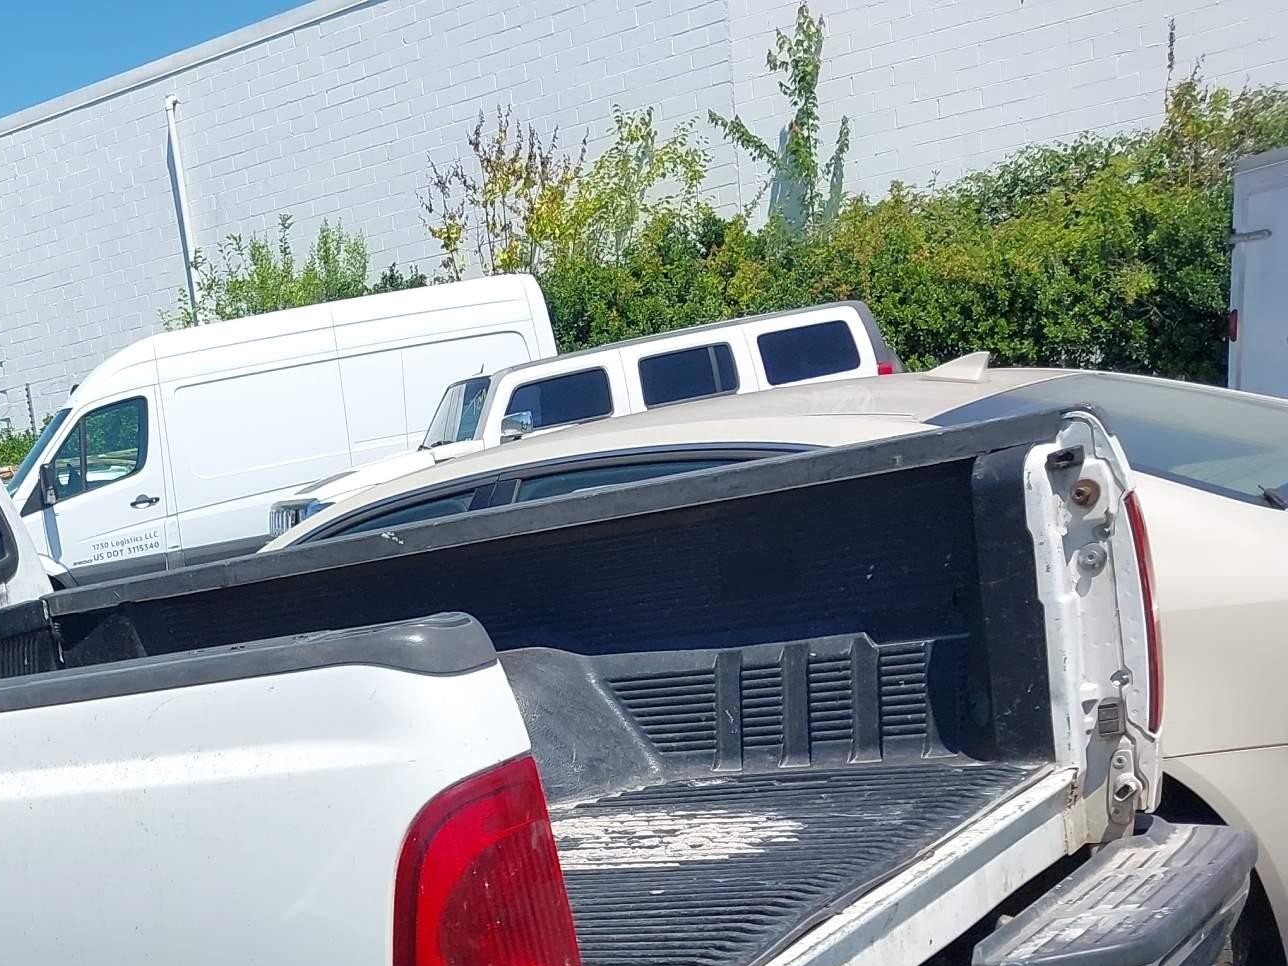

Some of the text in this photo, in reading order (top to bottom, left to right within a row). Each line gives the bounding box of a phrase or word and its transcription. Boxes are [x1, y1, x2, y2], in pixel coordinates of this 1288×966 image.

[92, 530, 159, 551] 1730 Logistics LLC
[93, 551, 105, 562] US
[106, 548, 124, 560] DOT
[127, 541, 160, 555] 3115340
